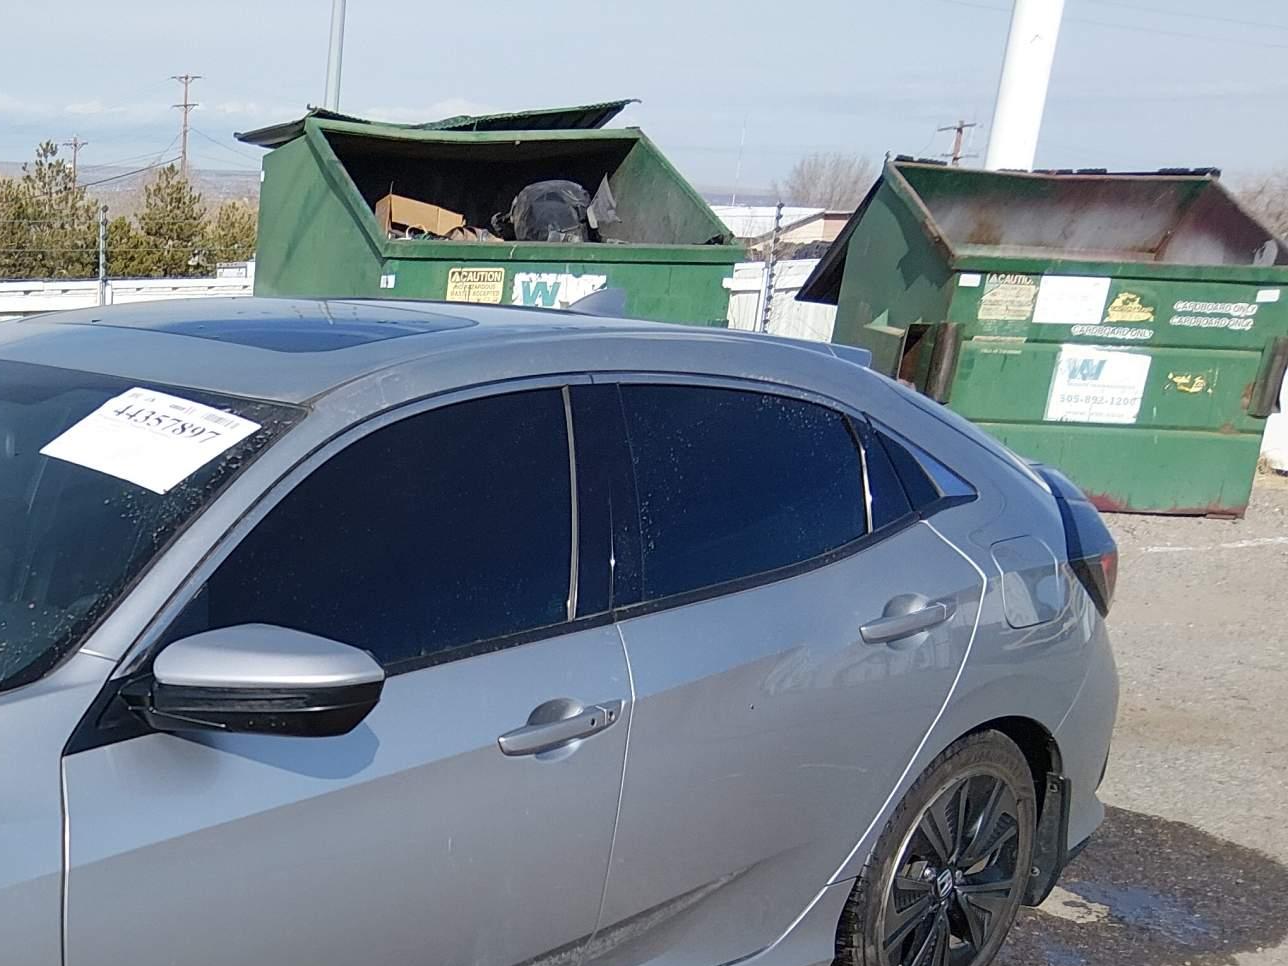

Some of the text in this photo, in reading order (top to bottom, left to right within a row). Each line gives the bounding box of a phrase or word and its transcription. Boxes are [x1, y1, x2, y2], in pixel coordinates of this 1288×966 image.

[461, 271, 502, 282] CAUTION
[998, 274, 1034, 285] CAUTIO
[113, 404, 222, 443] 44357897
